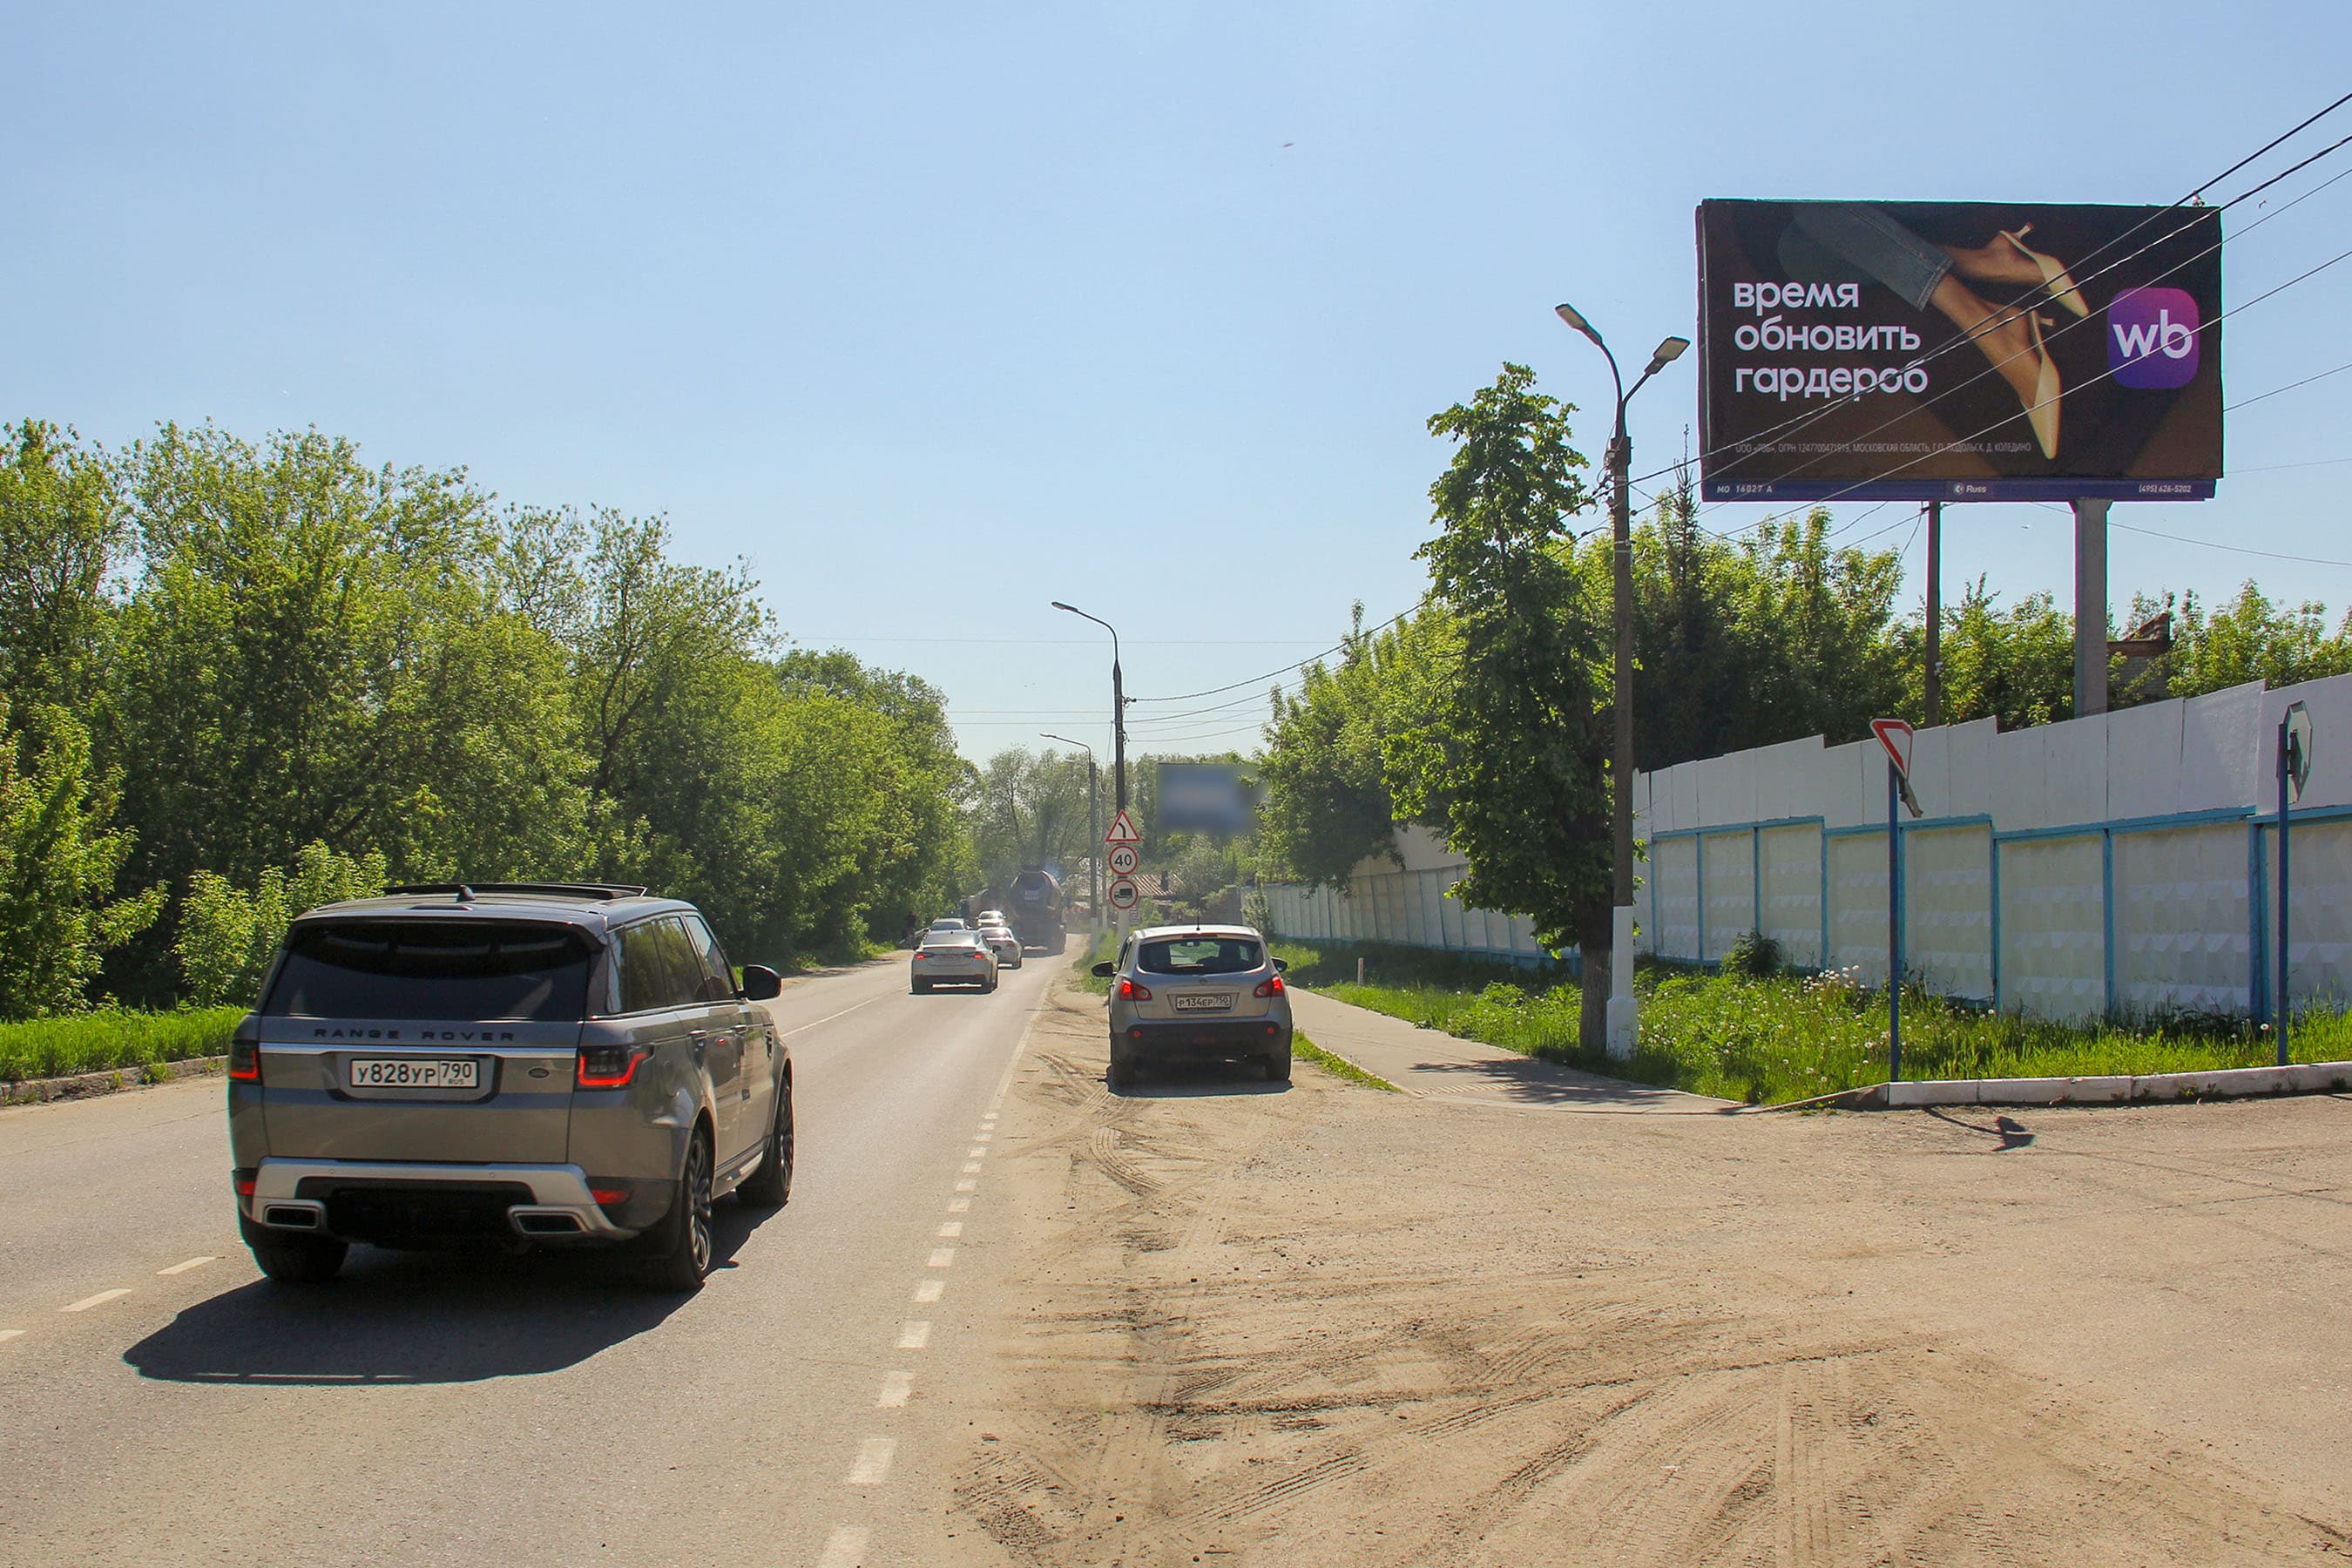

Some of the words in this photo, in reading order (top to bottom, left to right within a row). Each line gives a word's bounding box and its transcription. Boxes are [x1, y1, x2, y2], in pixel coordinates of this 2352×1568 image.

[1734, 282, 1859, 316] время
[1734, 314, 1922, 350] обновить
[2112, 309, 2193, 359] wb
[1778, 443, 1796, 453] ОГРН
[1853, 443, 1898, 453] МОСКОВСКАЯ
[1995, 443, 2031, 452] КОЛЕДИНО
[1736, 484, 1763, 493] 16027
[2139, 484, 2158, 493] (495)
[2159, 484, 2192, 493] 626-5202
[1115, 855, 1132, 866] 40
[314, 1029, 400, 1039] RANGE
[422, 1031, 515, 1042] ROVER
[441, 1063, 472, 1078] 790
